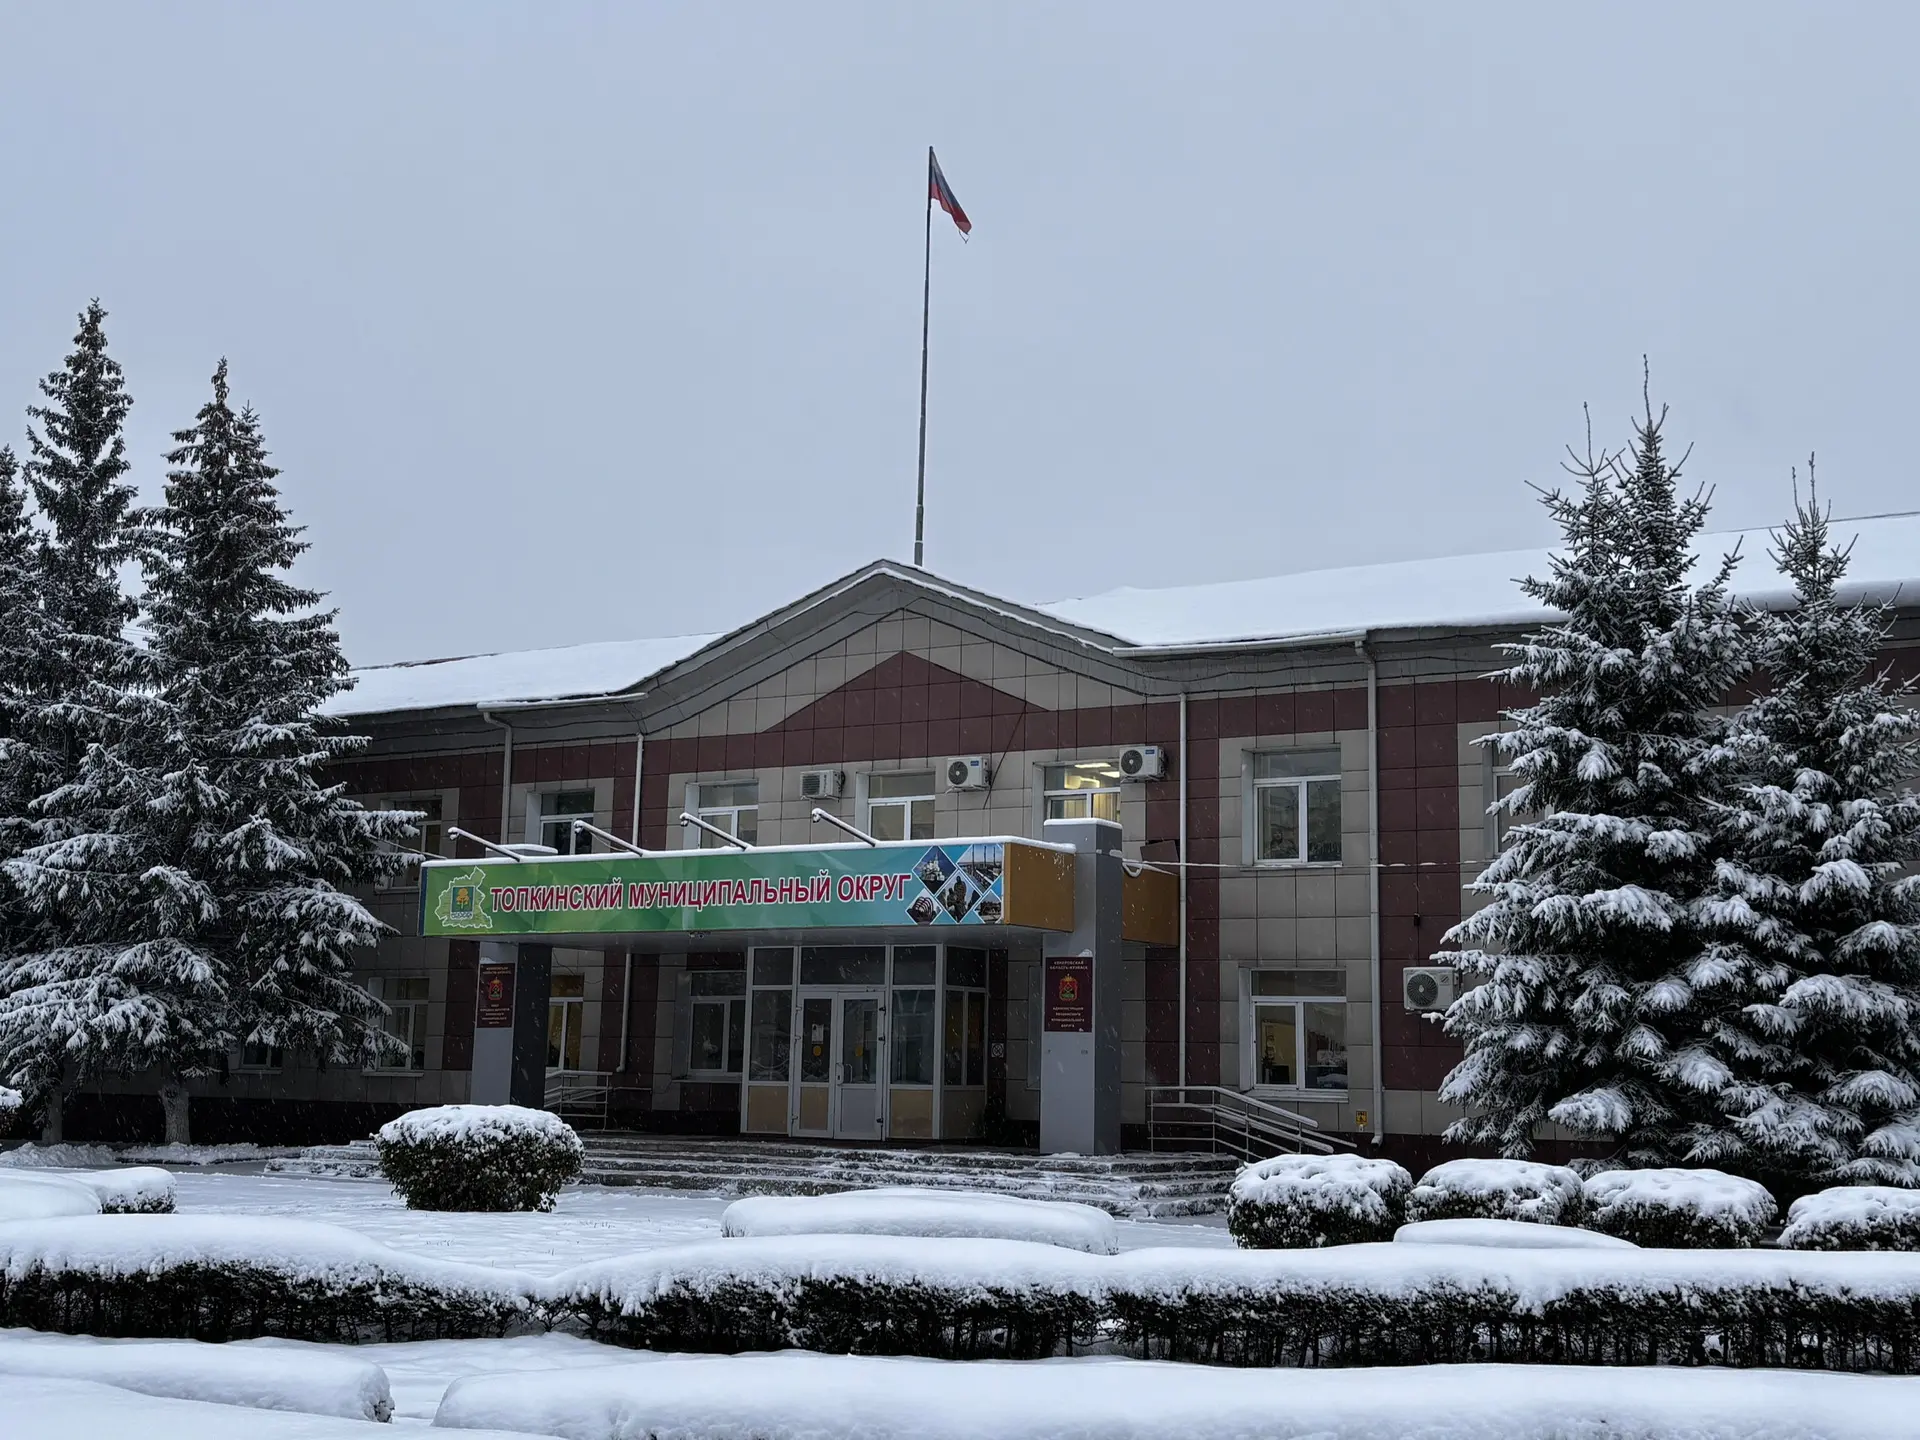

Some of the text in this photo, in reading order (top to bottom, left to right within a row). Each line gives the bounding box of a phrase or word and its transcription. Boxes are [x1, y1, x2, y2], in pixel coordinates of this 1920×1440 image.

[490, 869, 912, 912] ТОПКИНСКИЙ МУНИЦИПАЛЬНЫЙ ОКРУГ
